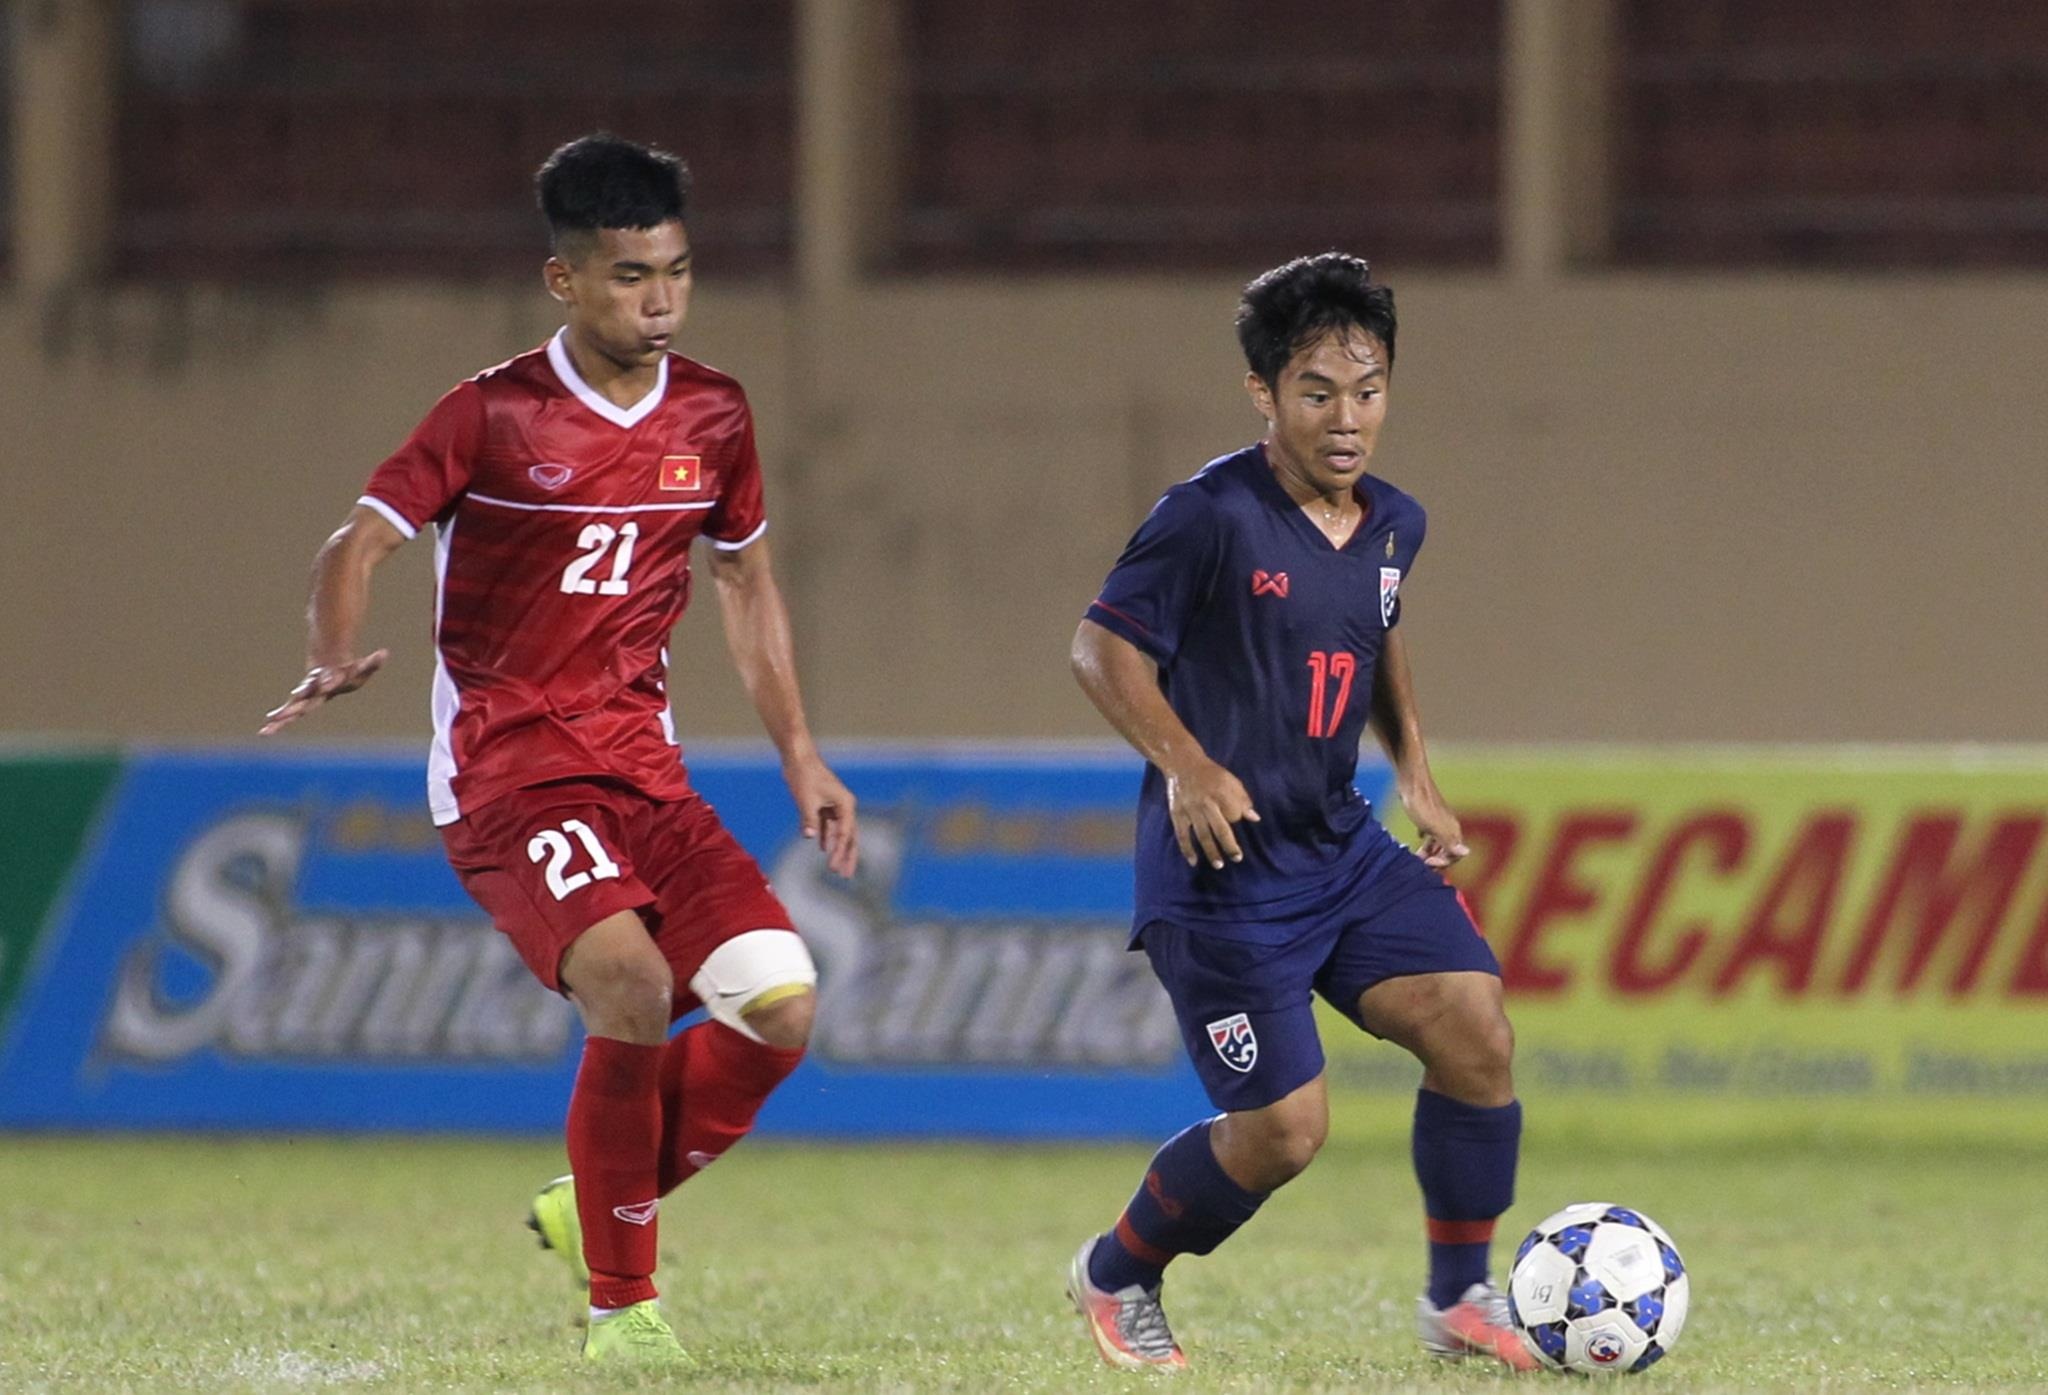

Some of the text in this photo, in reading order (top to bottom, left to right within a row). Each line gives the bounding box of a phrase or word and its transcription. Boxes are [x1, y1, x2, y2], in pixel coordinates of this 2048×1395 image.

[560, 522, 639, 596] 21
[1307, 651, 1355, 738] 17
[527, 819, 620, 901] 21
